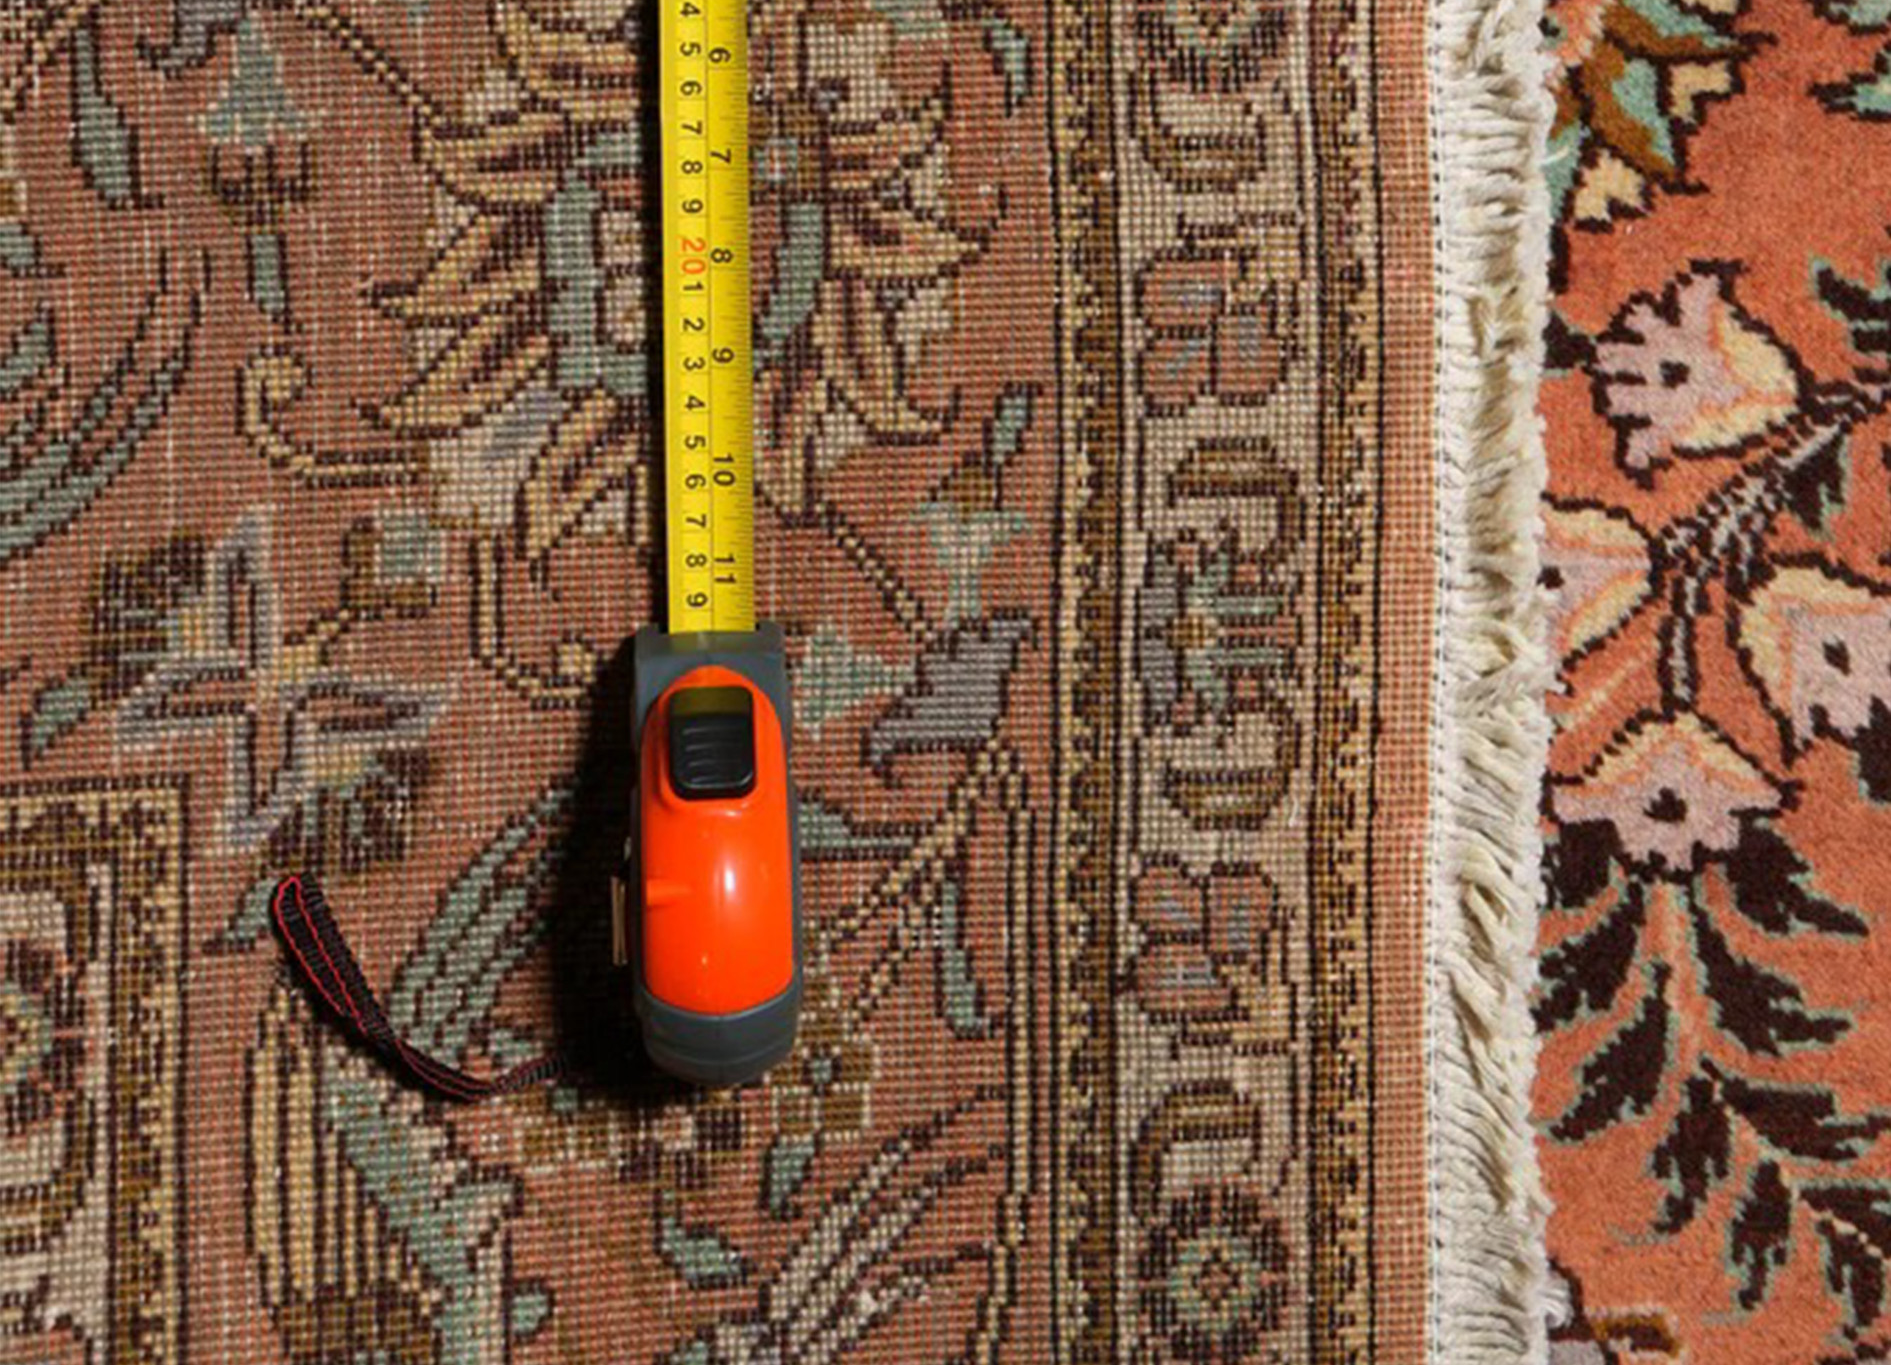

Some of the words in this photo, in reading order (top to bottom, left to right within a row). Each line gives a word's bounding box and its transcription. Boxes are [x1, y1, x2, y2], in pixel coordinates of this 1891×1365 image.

[680, 1, 701, 17] 4
[680, 42, 702, 57] 5
[708, 47, 732, 64] 6
[680, 80, 702, 96] 6
[682, 121, 703, 135] 7
[710, 148, 732, 164] 7
[681, 160, 703, 175] 8
[682, 199, 704, 214] 9
[680, 238, 707, 276] 20
[710, 248, 734, 264] 8
[683, 281, 704, 291] 1
[683, 317, 705, 332] 2
[712, 347, 735, 364] 9
[683, 357, 706, 371] 3
[685, 395, 705, 411] 4
[684, 435, 706, 450] 5
[712, 454, 736, 487] 10
[685, 474, 707, 490] 6
[686, 514, 707, 528] 7
[685, 553, 707, 568] 8
[714, 553, 737, 584] 11
[686, 592, 708, 608] 9
